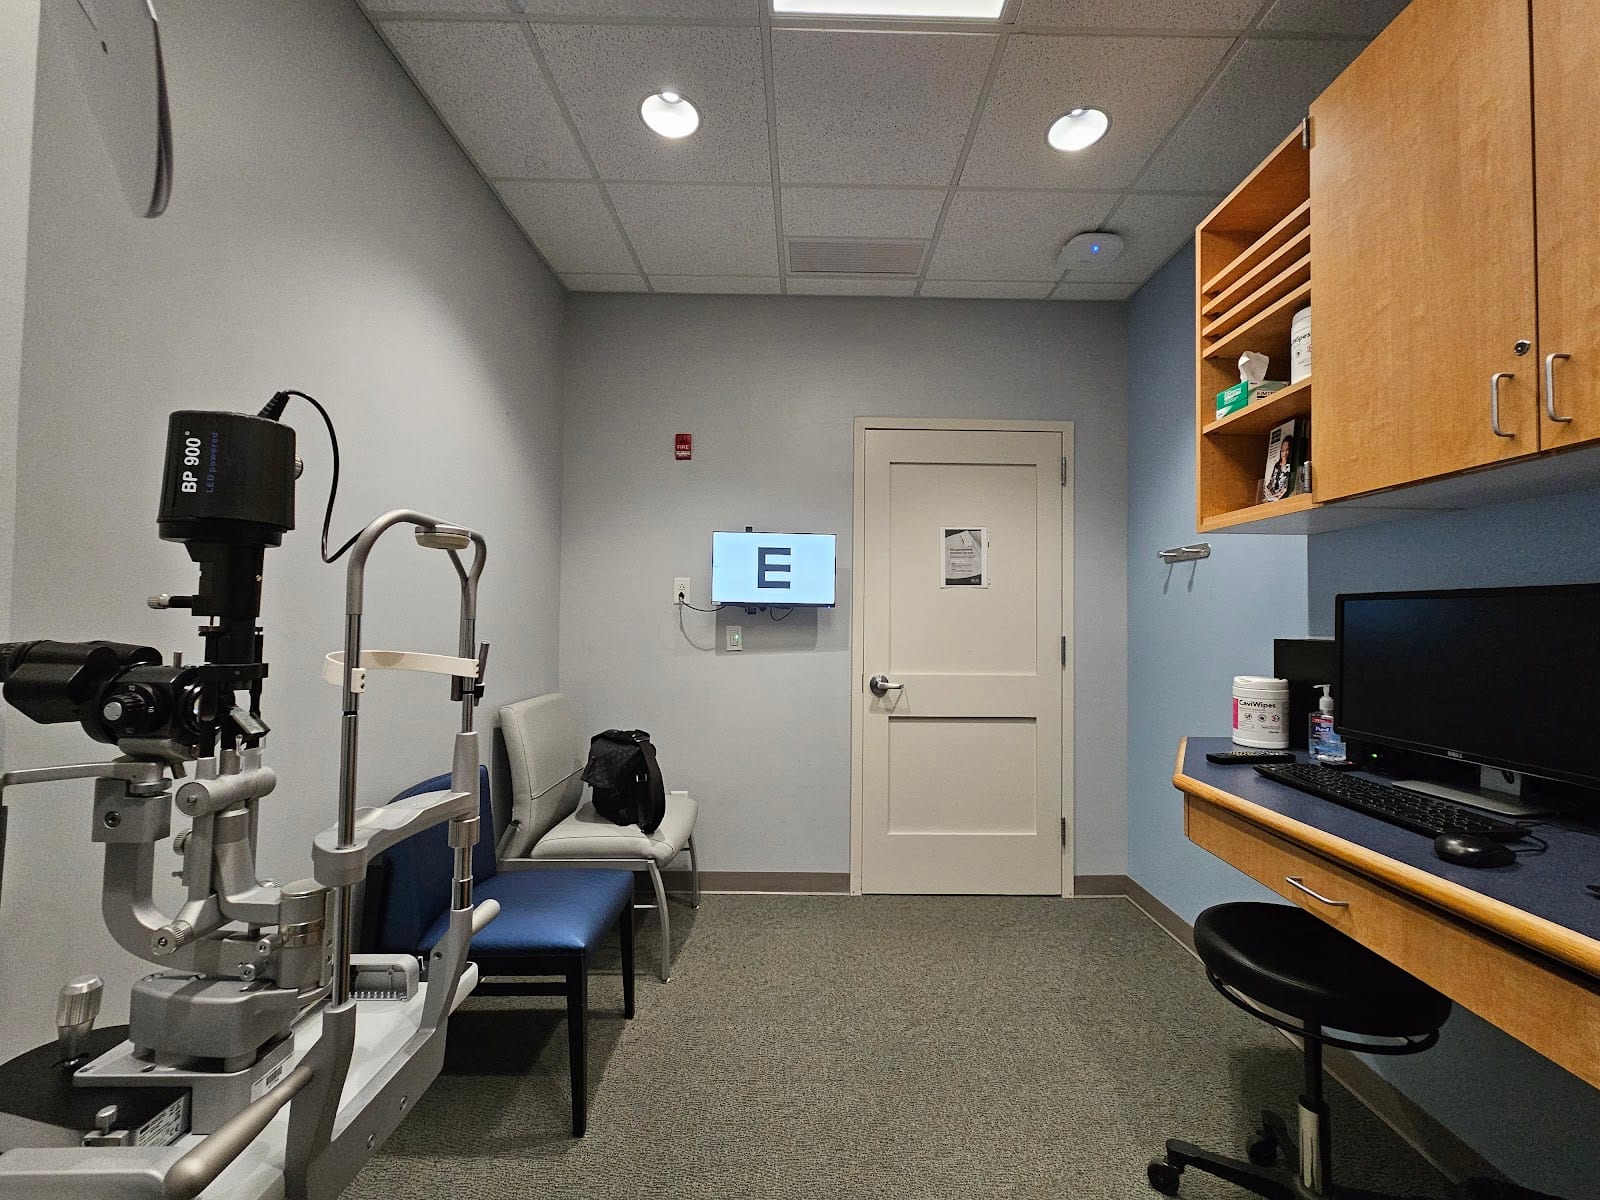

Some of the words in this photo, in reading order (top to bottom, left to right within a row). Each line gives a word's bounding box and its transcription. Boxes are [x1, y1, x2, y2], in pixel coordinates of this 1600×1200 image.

[208, 432, 219, 473] powered
[181, 471, 199, 493] BP
[205, 474, 215, 493] LED
[757, 546, 792, 589] E
[1239, 699, 1277, 710] CaviWipes
[1447, 750, 1464, 759] DELL
